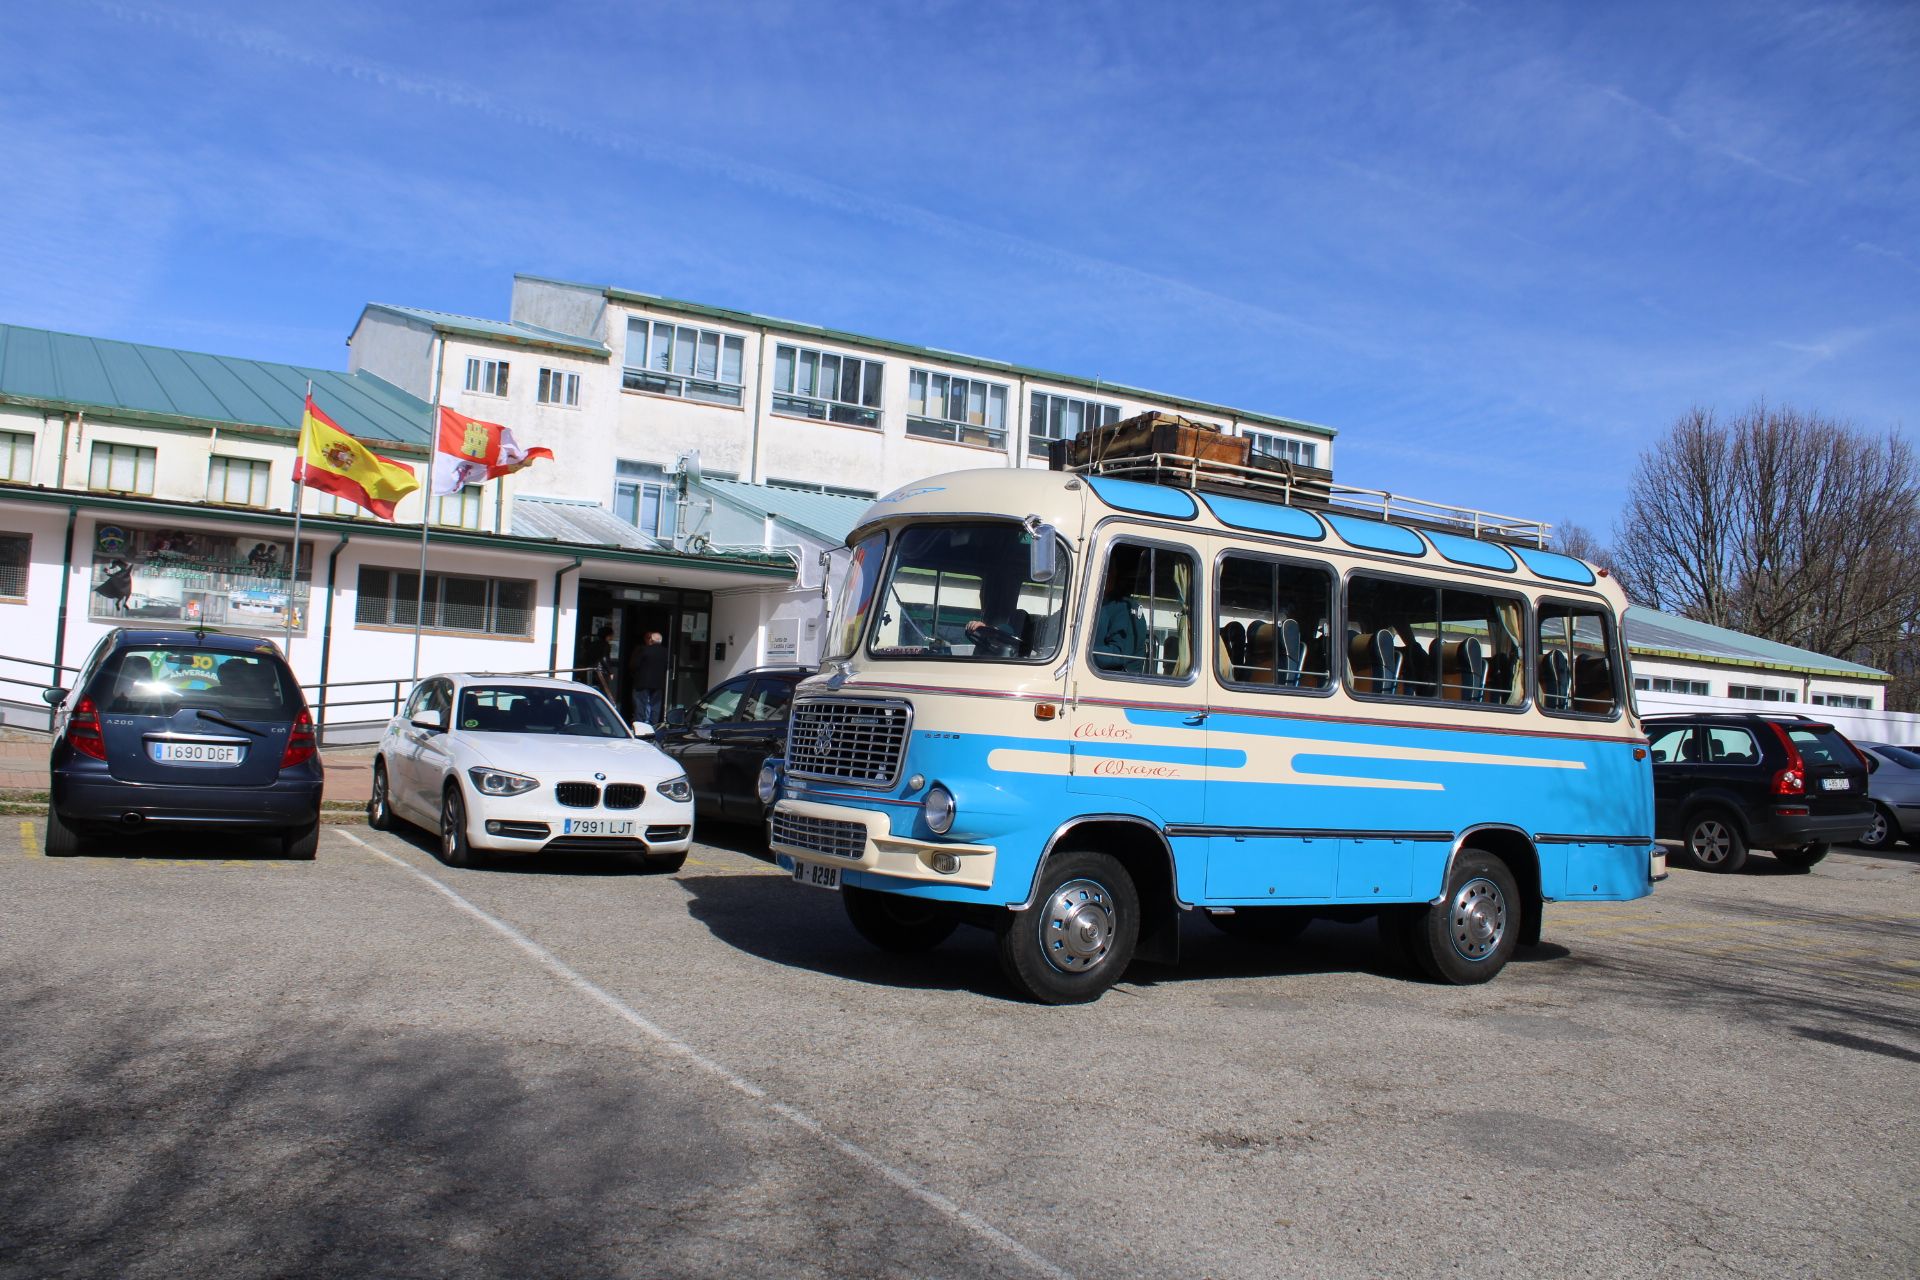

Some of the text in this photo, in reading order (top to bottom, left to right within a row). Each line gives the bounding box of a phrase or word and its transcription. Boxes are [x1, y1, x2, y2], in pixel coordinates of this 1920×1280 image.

[1073, 722, 1133, 740] Autos
[166, 745, 234, 761] 1690 DGF
[573, 820, 633, 834] 7991 LJT
